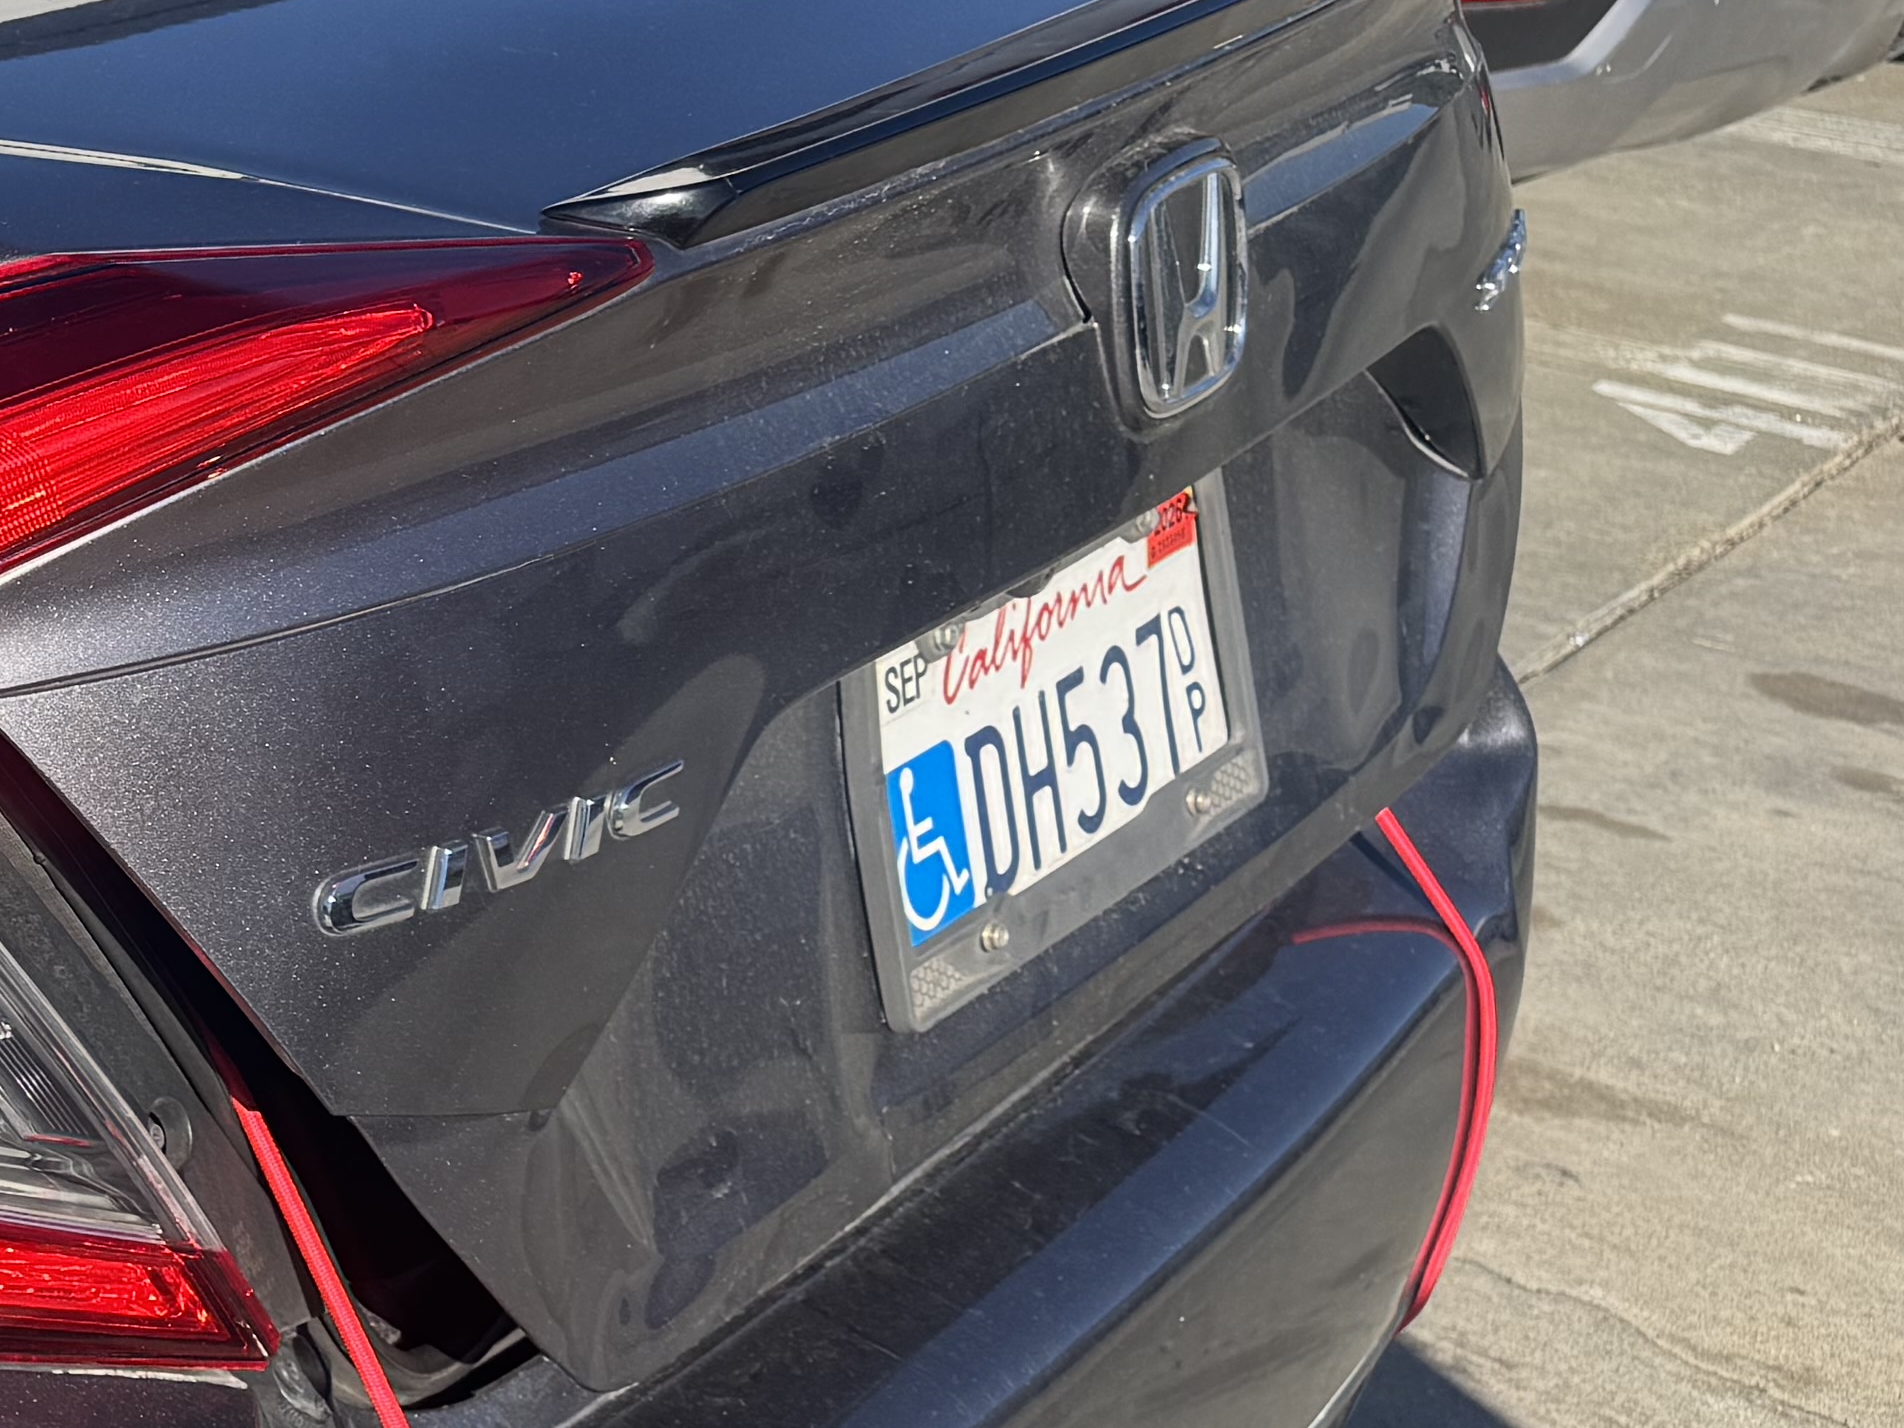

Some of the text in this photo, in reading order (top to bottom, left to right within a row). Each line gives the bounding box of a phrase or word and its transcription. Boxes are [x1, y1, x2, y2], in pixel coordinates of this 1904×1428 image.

[885, 656, 930, 715] SEP
[941, 552, 1147, 706] California
[966, 615, 1181, 896] DH537
[311, 759, 685, 937] CIVIC
